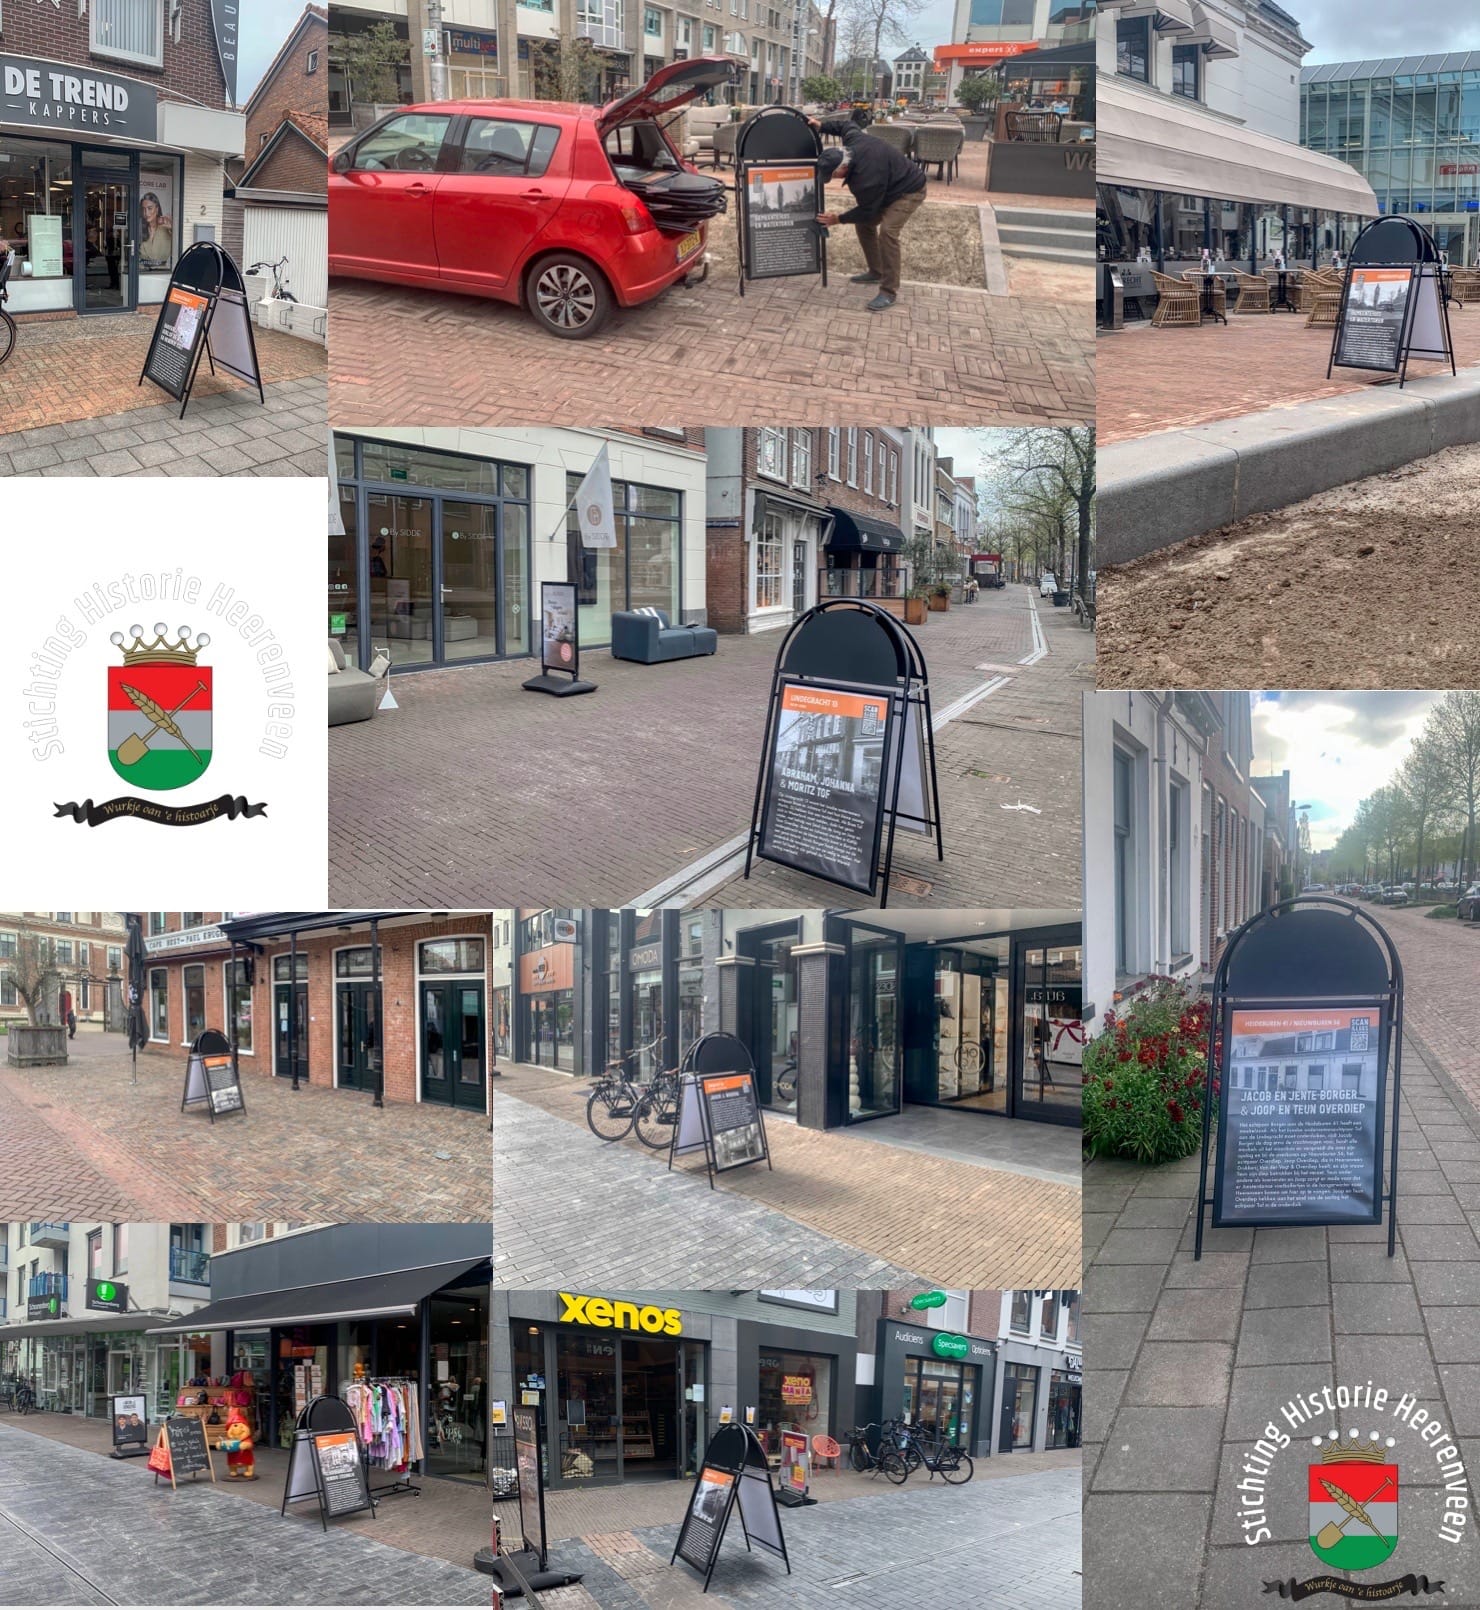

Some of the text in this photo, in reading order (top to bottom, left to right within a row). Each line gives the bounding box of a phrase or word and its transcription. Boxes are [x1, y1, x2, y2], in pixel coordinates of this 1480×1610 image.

[968, 46, 1003, 54] expert
[4, 65, 129, 112] DE TREND
[29, 101, 110, 126] KAPPERS
[200, 204, 207, 216] 2
[787, 780, 816, 796] MORITZ
[816, 787, 831, 799] TOF
[820, 776, 855, 793] JOHANNA
[632, 950, 658, 966] OMODA
[1351, 1018, 1369, 1026] SCAN
[1240, 1089, 1358, 1102] JACOB EN JENTE BORGER
[1240, 1103, 1366, 1116] & JOOP EN TEUN OVERDIEP
[558, 1291, 683, 1337] xenos
[894, 1330, 924, 1345] Audiciens
[938, 1338, 967, 1352] Specsavers
